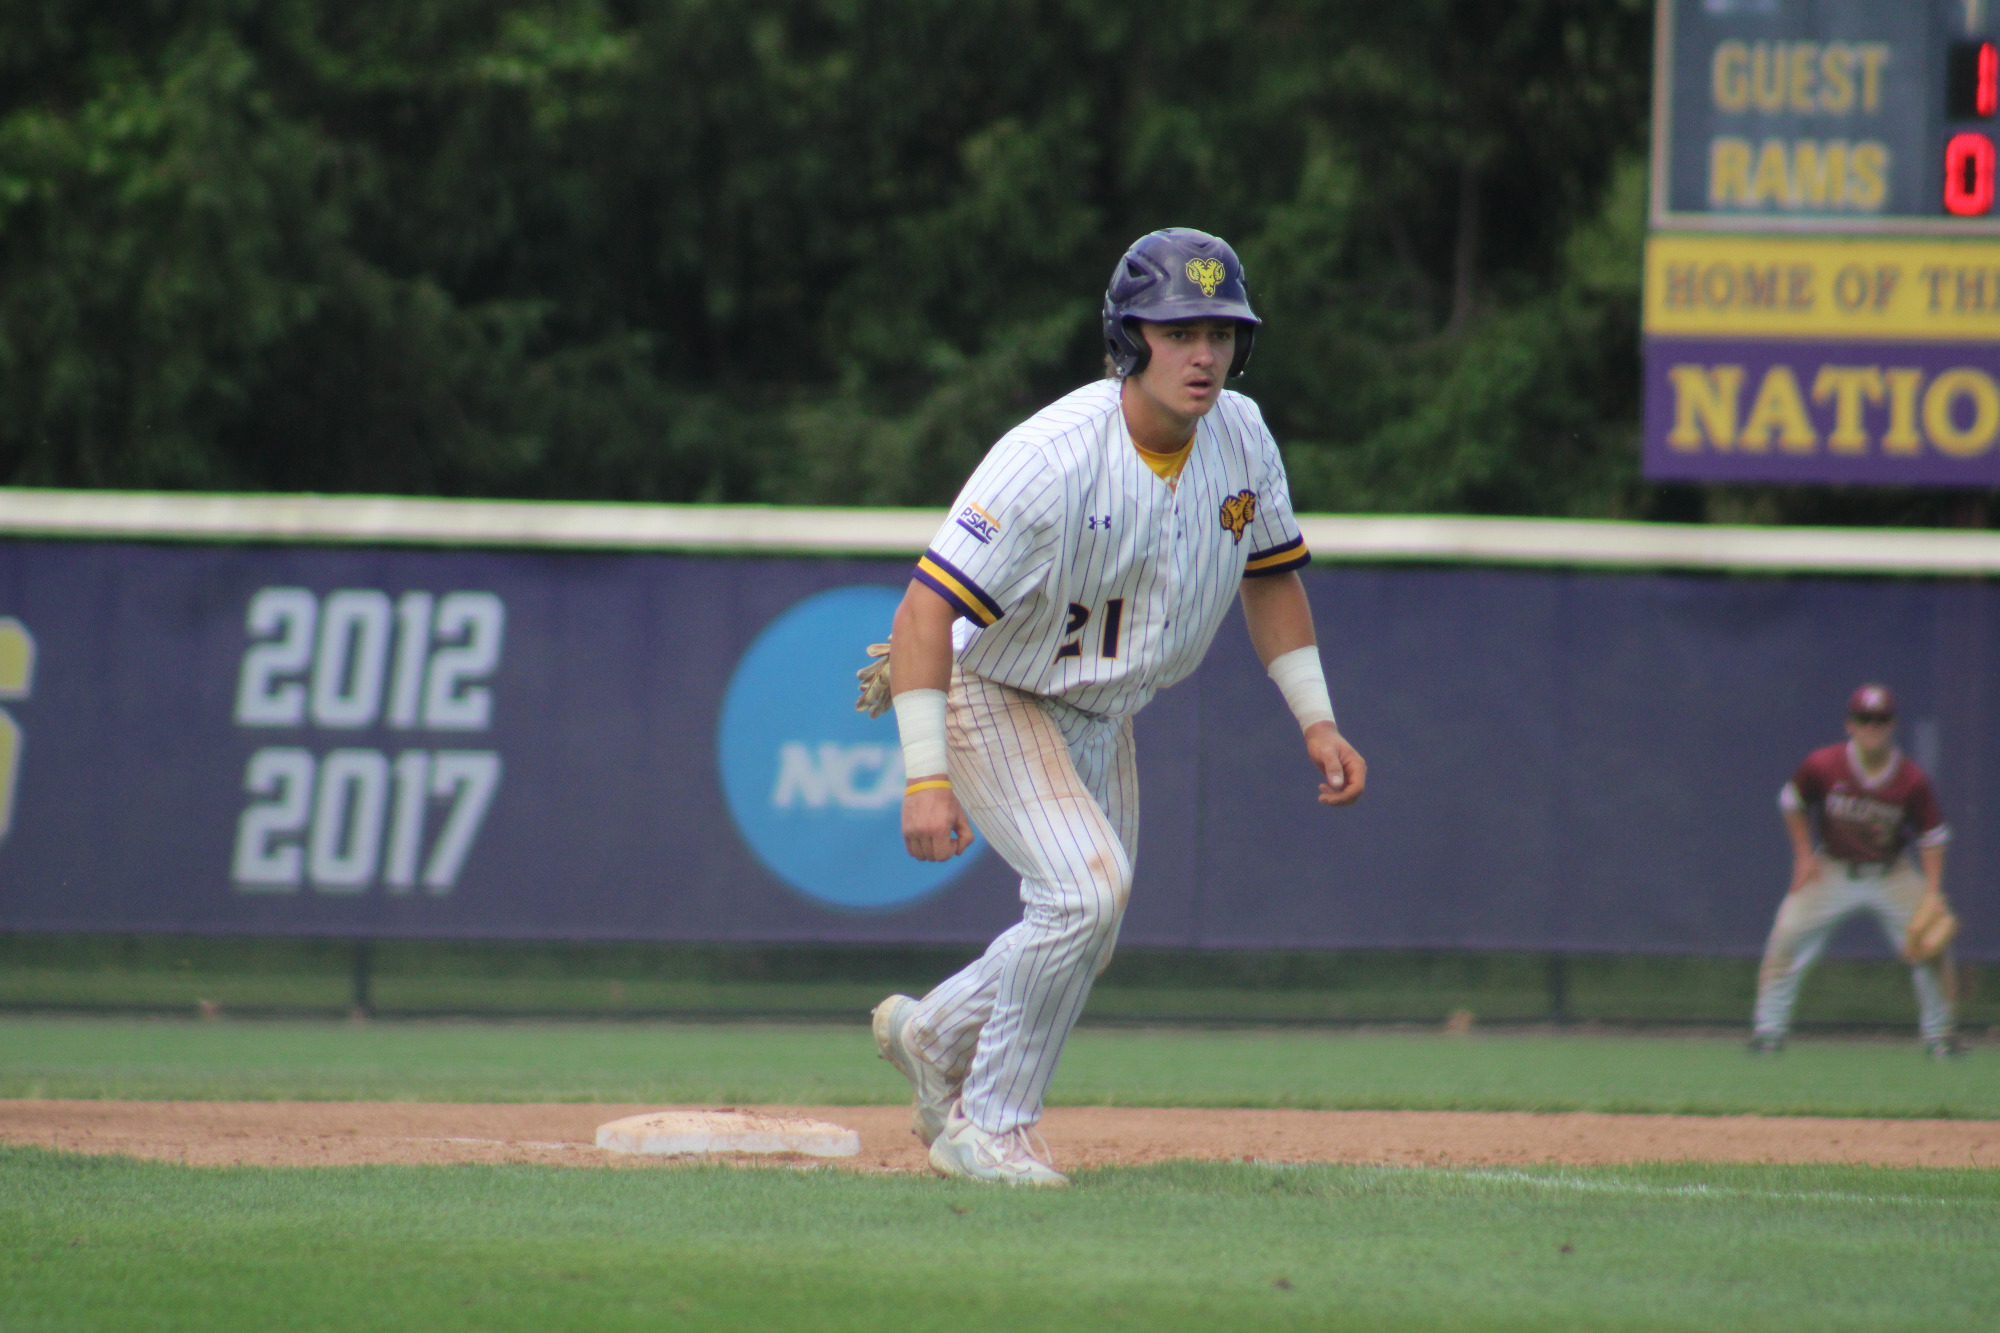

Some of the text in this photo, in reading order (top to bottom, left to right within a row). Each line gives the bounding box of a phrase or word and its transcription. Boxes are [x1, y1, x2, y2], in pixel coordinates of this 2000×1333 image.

[1712, 41, 1888, 116] GUEST
[1976, 42, 1999, 117] 1
[1710, 139, 1887, 210] RAMS
[1944, 133, 1996, 216] 0
[1664, 263, 2000, 316] HOME OF TH
[1668, 364, 2000, 457] NATIO
[960, 506, 999, 541] PSAC
[234, 586, 504, 730] 2012
[1052, 597, 1124, 666] 21
[772, 741, 906, 809] NCA
[231, 747, 502, 893] 2017
